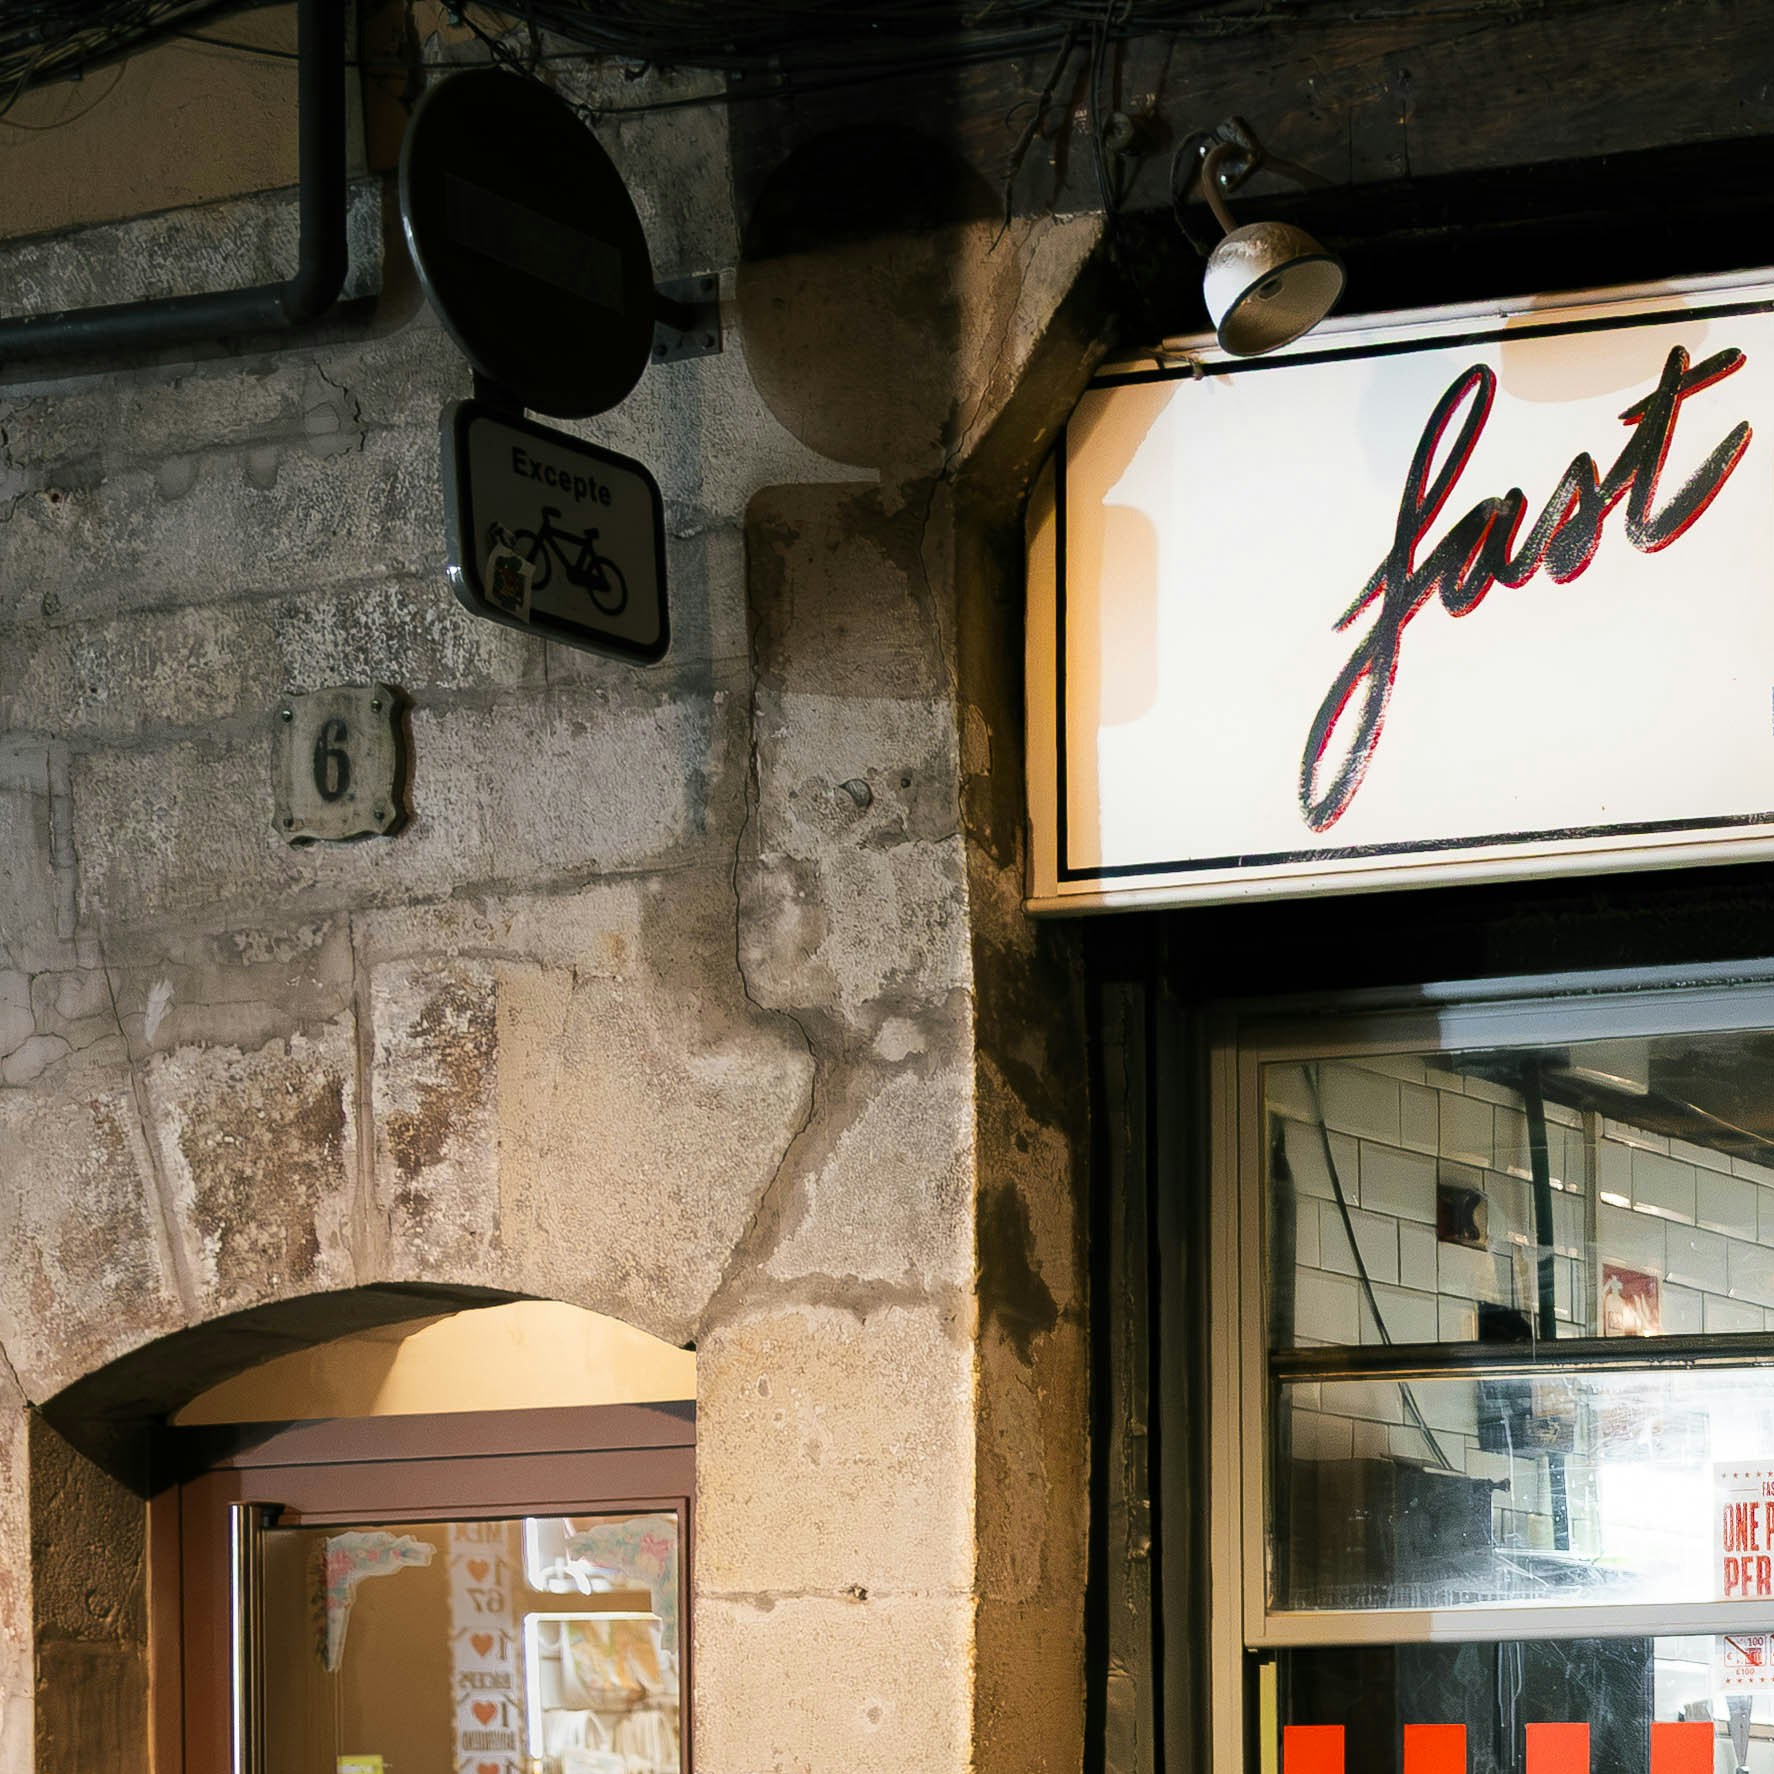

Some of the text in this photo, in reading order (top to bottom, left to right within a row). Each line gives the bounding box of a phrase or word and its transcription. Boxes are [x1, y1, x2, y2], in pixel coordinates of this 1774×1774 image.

[511, 446, 613, 507] Excepte
[1302, 343, 1753, 834] fast
[313, 719, 351, 803] 6
[1722, 1501, 1761, 1553] ONE
[1723, 1554, 1773, 1598] PER
